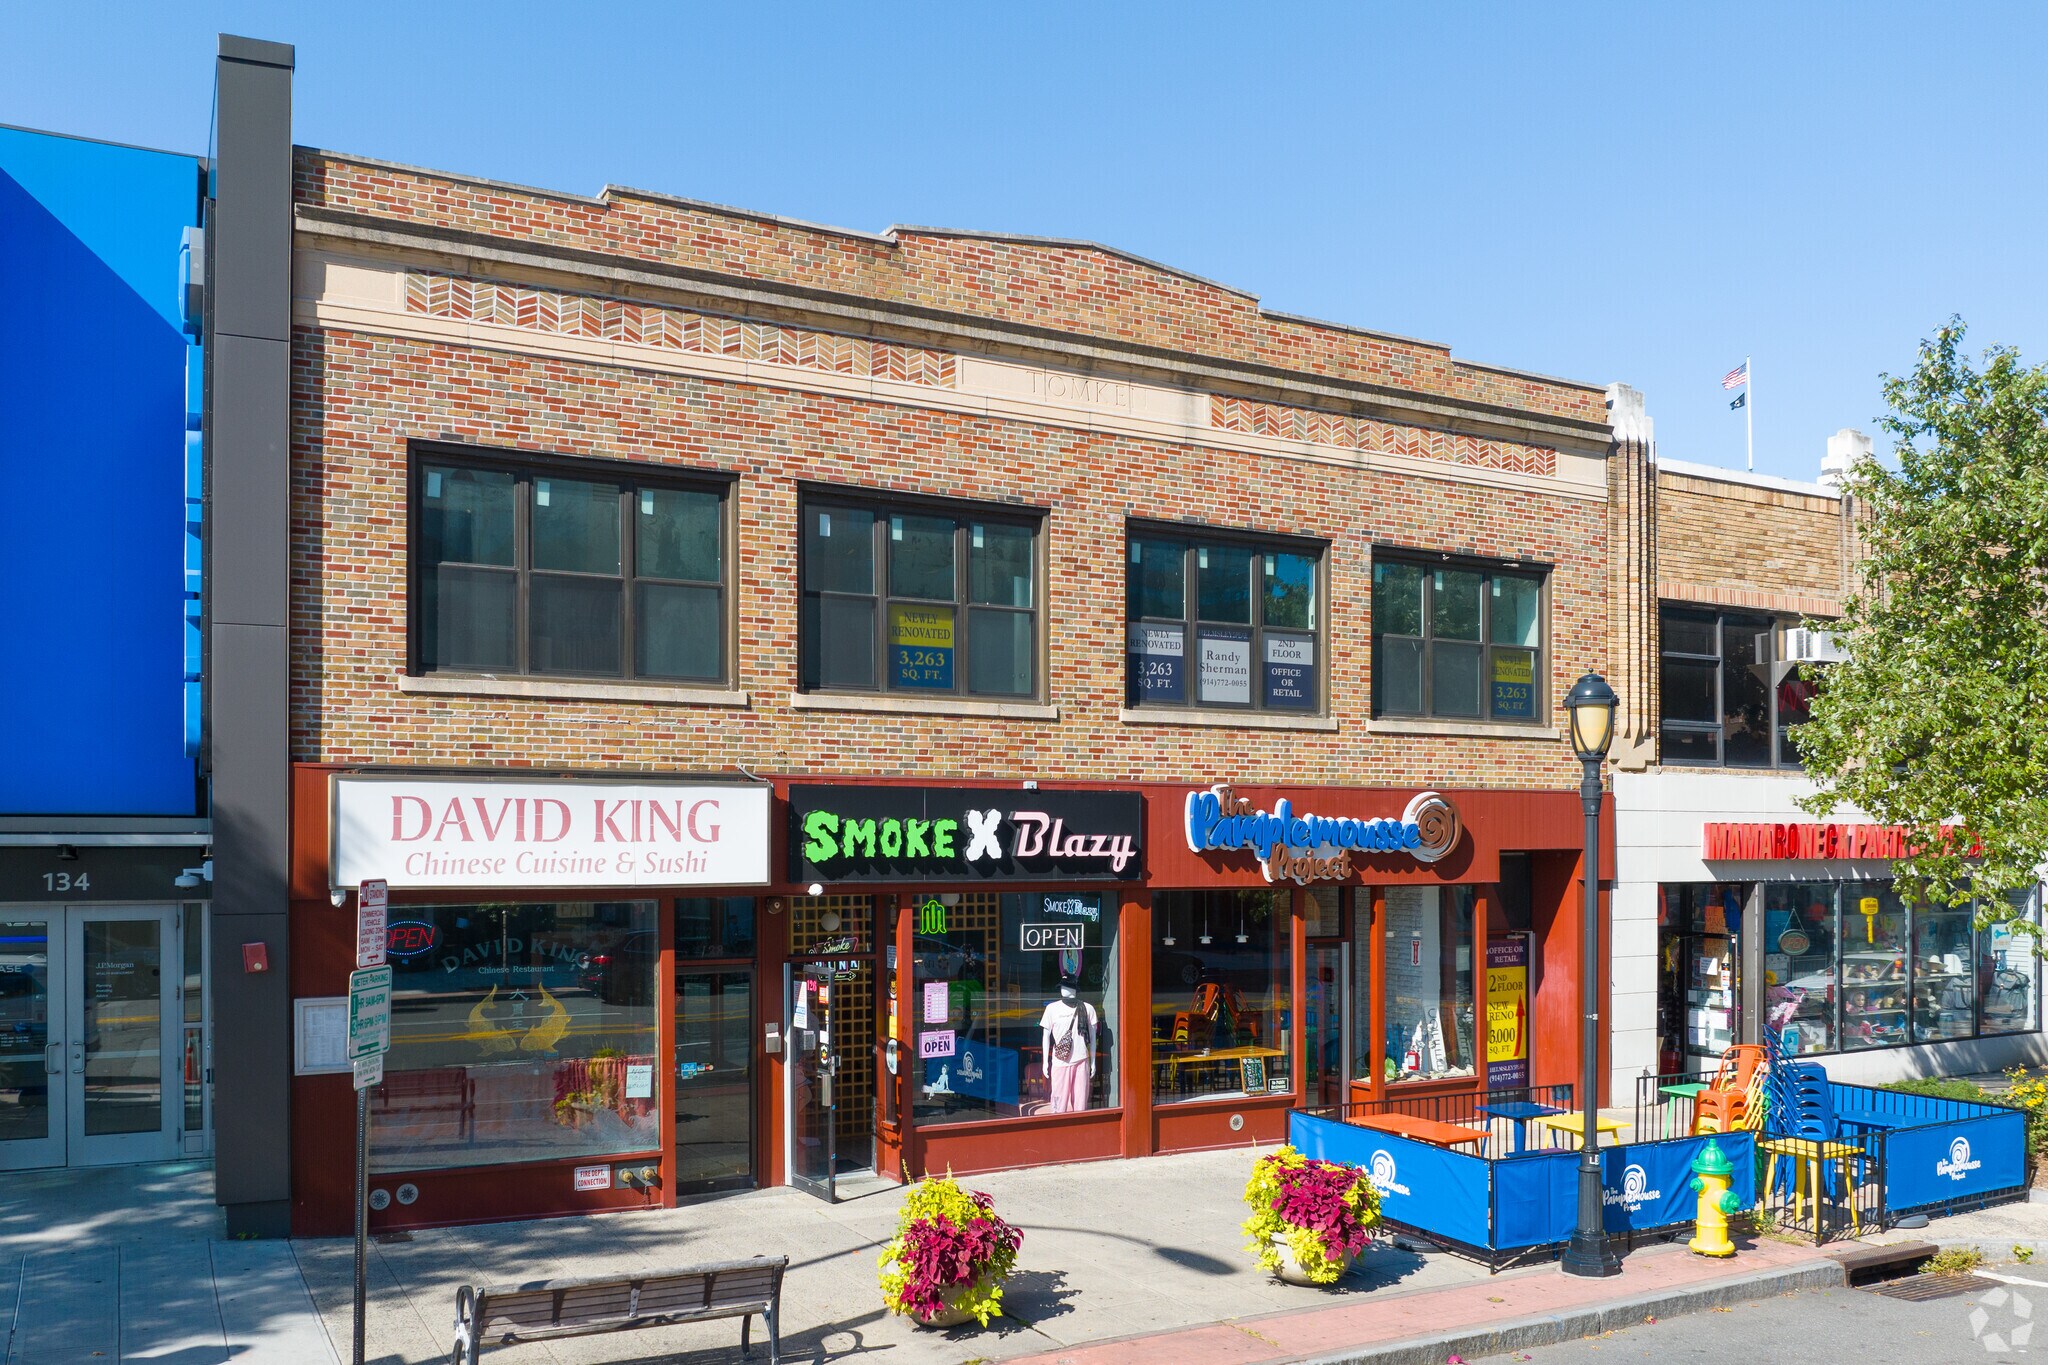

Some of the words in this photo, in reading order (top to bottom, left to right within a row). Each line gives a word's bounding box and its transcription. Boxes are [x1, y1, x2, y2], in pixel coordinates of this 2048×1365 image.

[904, 612, 938, 624] NEWLY
[892, 626, 950, 640] RENOVATED
[1142, 629, 1170, 639] NEWLY
[1130, 638, 1181, 650] RENOVATED
[1278, 640, 1296, 648] 2ND
[899, 651, 945, 667] 3,263
[1206, 650, 1241, 664] Randy
[1272, 649, 1302, 659] FLOOR
[902, 669, 920, 680] SQ.
[925, 670, 942, 680] FT.
[1137, 661, 1173, 677] 3,263
[1199, 663, 1248, 675] Sherman
[1271, 667, 1301, 677] OFFICE
[1138, 678, 1154, 689] SQ.
[1157, 679, 1173, 689] FT.
[1199, 678, 1248, 688] (914)772-0055
[1281, 679, 1294, 687] OR
[1272, 688, 1302, 698] RETAIL
[1496, 687, 1527, 700] 3,263
[1215, 785, 1253, 817] The
[391, 795, 572, 842] DAVID
[593, 799, 721, 843] KING
[1187, 792, 1422, 859] Pamplemousse
[965, 809, 1002, 861] X
[1008, 811, 1137, 873] Blazy
[1706, 822, 1851, 860] MAMARONECK
[405, 851, 506, 876] Chinese
[515, 851, 607, 875] Cuisine
[615, 852, 635, 874] &
[643, 850, 708, 874] Sushi
[1268, 842, 1353, 885] Project
[42, 872, 91, 892] 134
[369, 889, 385, 900] STANDING
[361, 909, 384, 919] COMMERCIAL
[364, 918, 381, 927] VEHICLE
[386, 927, 435, 949] OPEN
[1026, 928, 1080, 947] OPEN
[375, 943, 383, 952] SAT
[822, 936, 851, 953] Smoke
[1488, 946, 1513, 955] OFFICE
[1513, 945, 1524, 953] OR
[441, 937, 524, 974] DAVID
[530, 938, 590, 974] KING
[1494, 955, 1519, 963] RETAIL
[478, 965, 510, 975] Chinese
[513, 964, 555, 974] Restaurant
[353, 976, 370, 988] METER
[369, 973, 389, 984] PARKING
[806, 980, 817, 992] 126
[1498, 981, 1523, 991] FLOOR
[1489, 1001, 1510, 1011] NEW
[1489, 1011, 1515, 1021] RENO
[351, 1019, 358, 1036] 3
[1489, 1027, 1516, 1044] 3,000
[924, 1040, 951, 1053] OPEN
[1489, 1045, 1500, 1054] SQ.
[1501, 1044, 1512, 1053] FT.
[1488, 1071, 1525, 1084] (914)772-0055
[580, 1169, 591, 1178] FIRE
[591, 1168, 605, 1177] DEPT.
[577, 1176, 607, 1187] CONNECTION
[1602, 1189, 1661, 1206] Pamplemousse
[1623, 1202, 1642, 1212] Project
